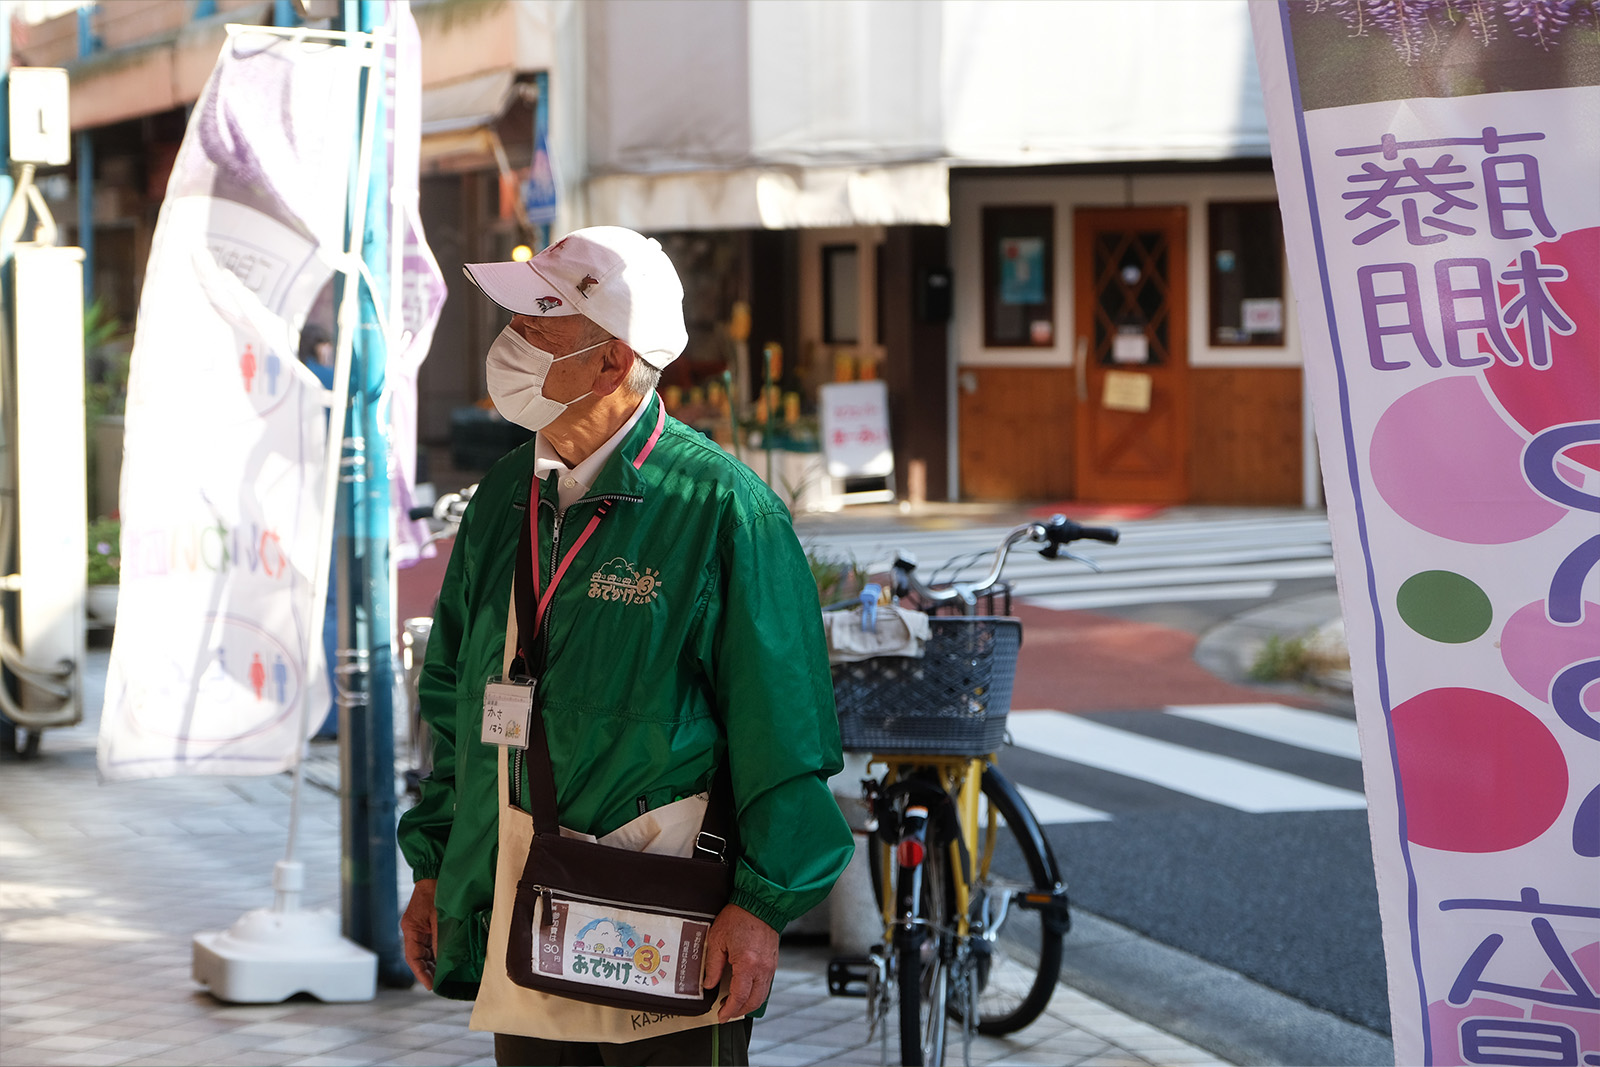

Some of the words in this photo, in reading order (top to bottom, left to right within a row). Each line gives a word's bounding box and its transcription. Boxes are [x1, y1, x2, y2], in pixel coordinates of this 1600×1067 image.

[588, 582, 636, 606] おでかけ
[572, 954, 633, 985] おでかけ
[638, 949, 654, 971] 3
[634, 974, 650, 986] さん
[631, 1012, 681, 1031] KASA
